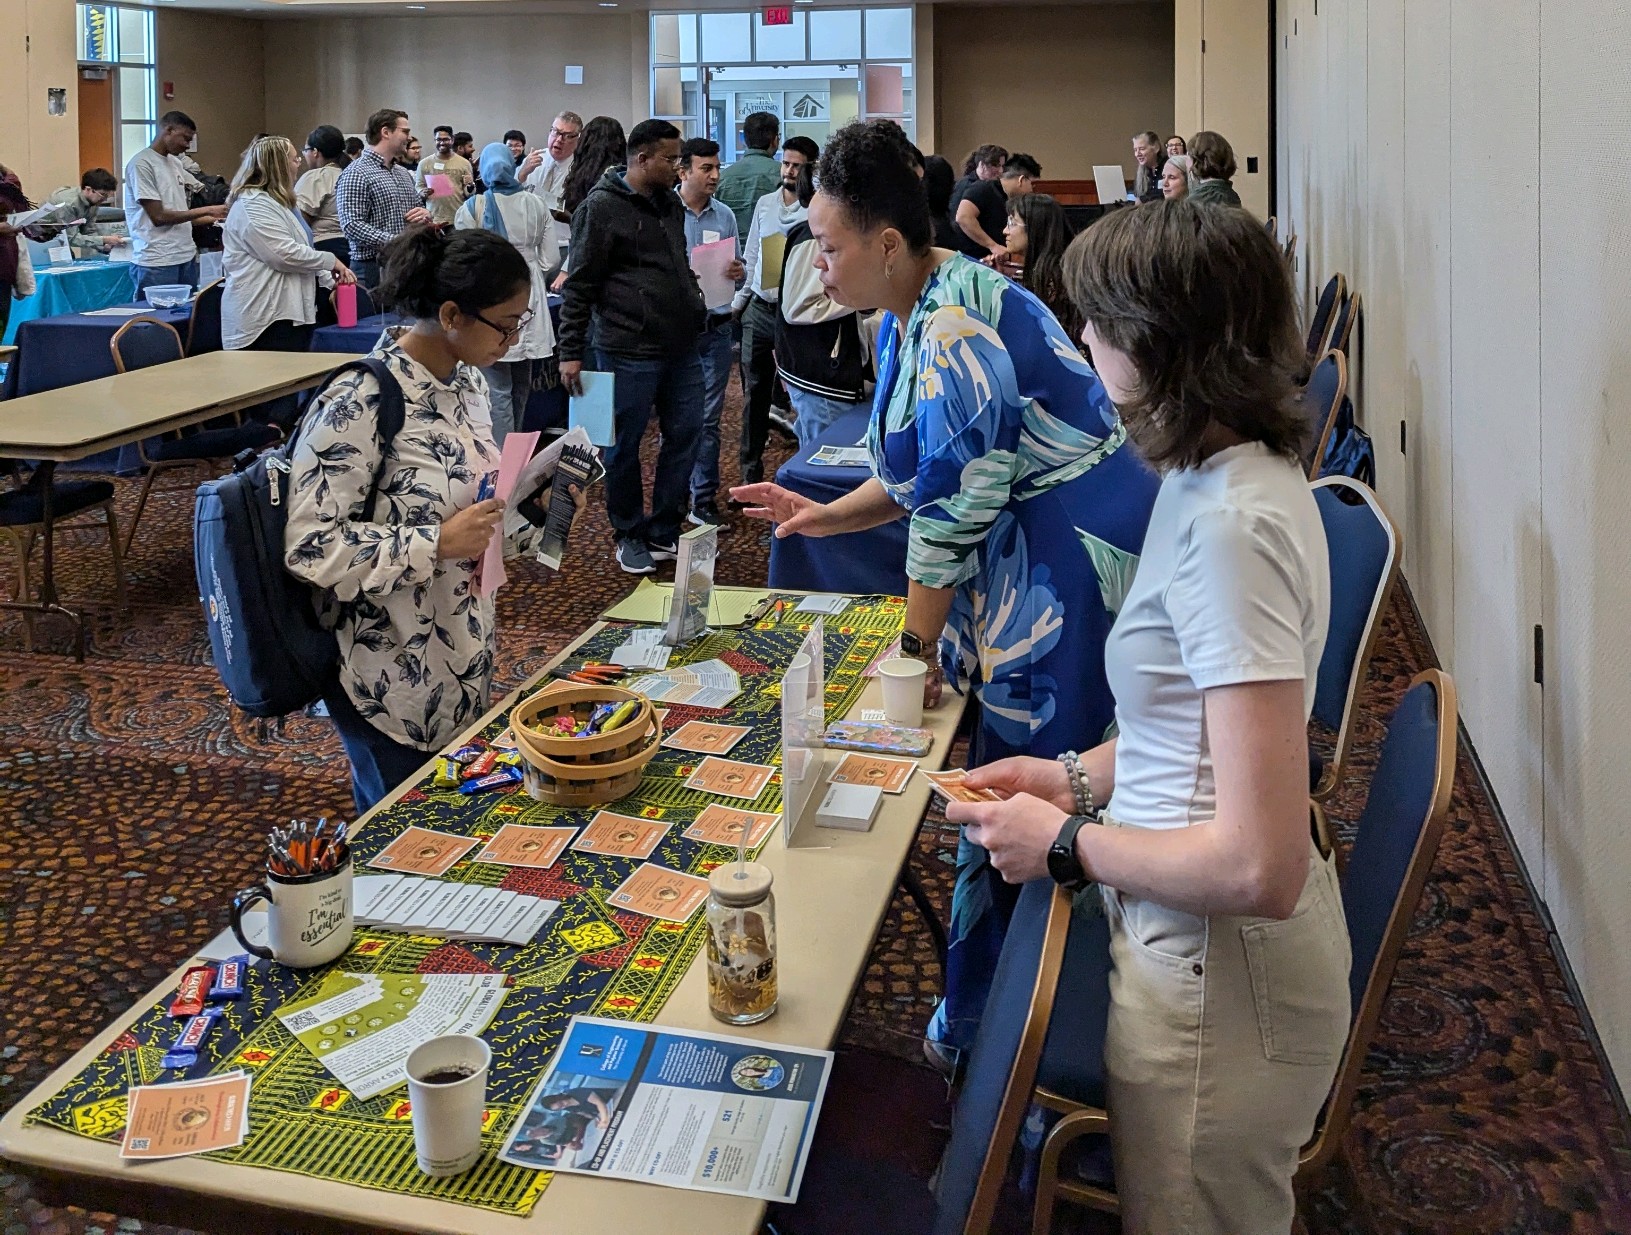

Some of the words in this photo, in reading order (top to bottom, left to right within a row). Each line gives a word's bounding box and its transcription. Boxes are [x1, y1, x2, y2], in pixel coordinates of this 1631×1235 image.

[301, 898, 348, 942] essential
[308, 908, 328, 927] I'm
[223, 963, 237, 988] CRUNCH
[184, 1017, 208, 1045] CRUNCH
[611, 1110, 625, 1128] PROGRAM
[722, 1109, 733, 1122] $21
[601, 1127, 617, 1149] PLACEMENT
[597, 1148, 607, 1157] AND
[702, 1146, 721, 1178] $10,000+
[649, 1166, 657, 1175] WHY
